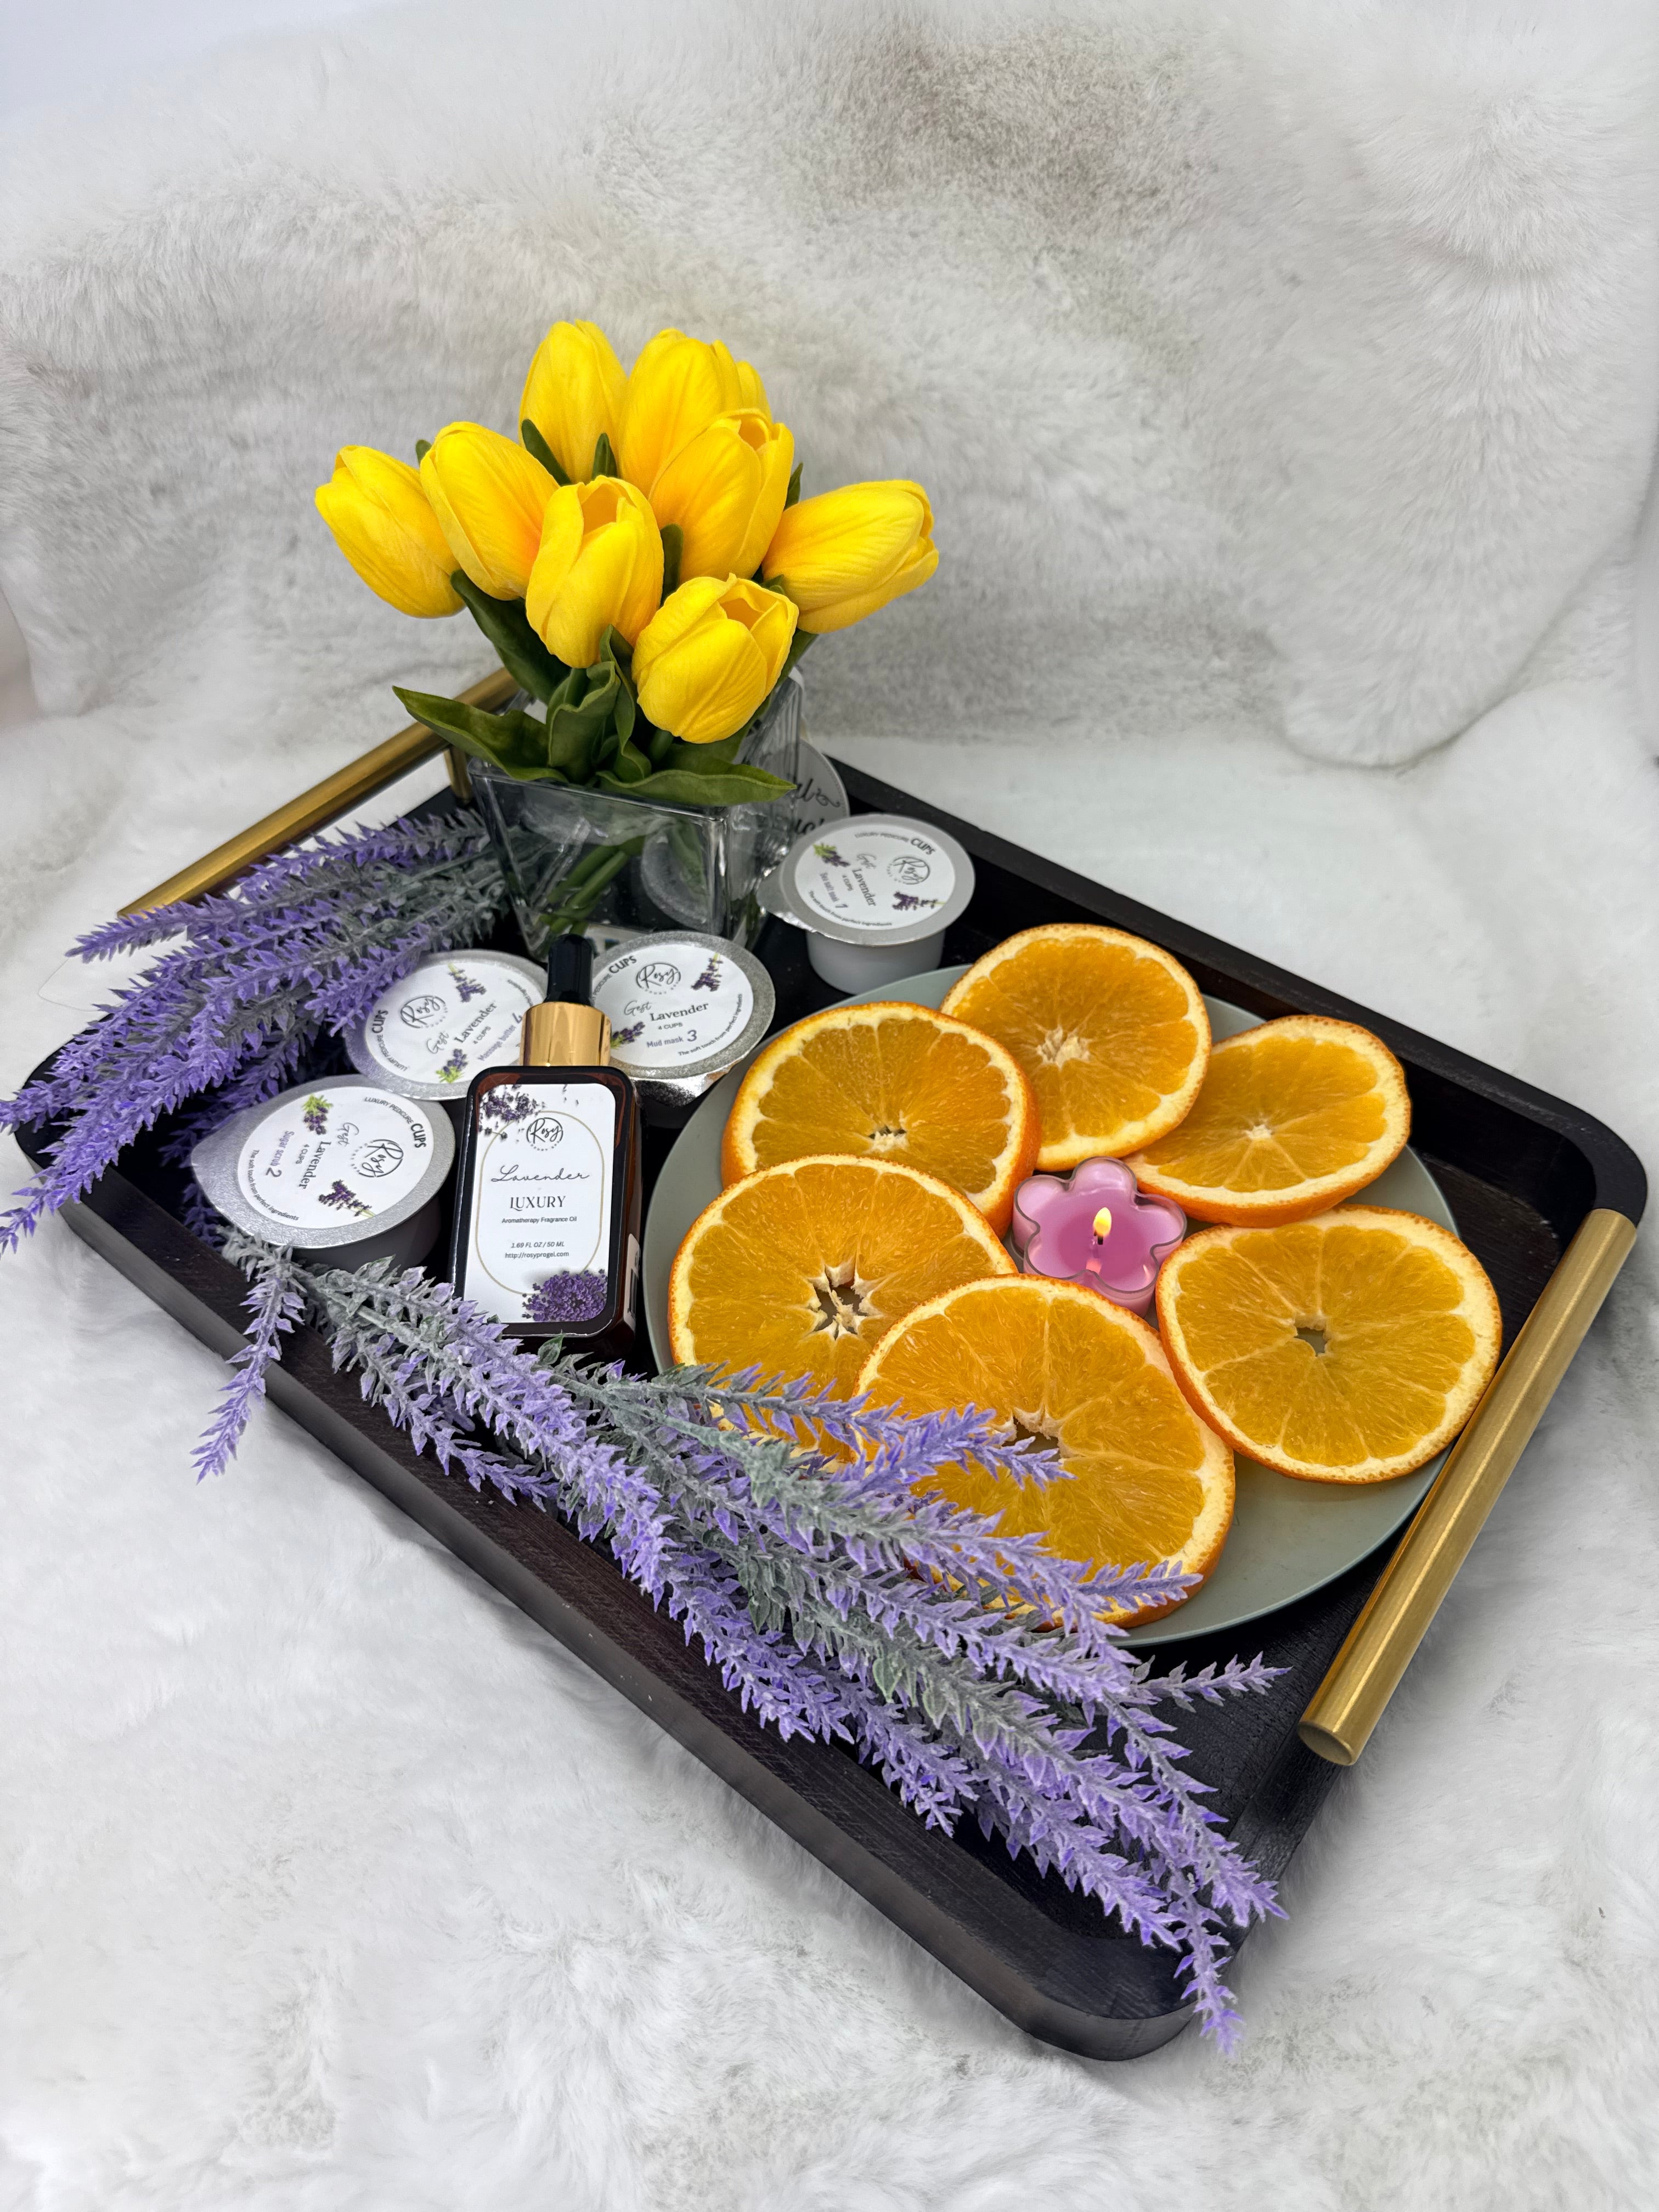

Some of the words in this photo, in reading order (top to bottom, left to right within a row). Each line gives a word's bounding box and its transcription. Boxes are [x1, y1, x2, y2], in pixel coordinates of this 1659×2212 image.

[911, 838, 935, 855] CUPS
[852, 868, 876, 906] Lavender
[593, 973, 613, 996] PEDICURE
[609, 956, 636, 973] CUPS
[639, 965, 678, 989] Rosy
[400, 997, 440, 1025] Rosy
[650, 1003, 709, 1022] Lavender
[372, 1010, 388, 1033] CUPS
[453, 1003, 496, 1043] Lavender
[476, 1025, 491, 1041] CUPS
[664, 1036, 684, 1045] mask
[687, 1030, 697, 1042] 3
[701, 1040, 715, 1049] touch
[715, 1031, 726, 1041] from
[725, 1016, 737, 1033] perfect
[477, 1041, 503, 1061] Massage
[499, 1025, 516, 1041] butter
[387, 1057, 408, 1071] LUXURY
[364, 1097, 391, 1106] LUXURY
[389, 1104, 414, 1124] PEDICURE
[411, 1124, 426, 1148] CUPS
[529, 1118, 562, 1144] Rosy
[279, 1131, 295, 1148] Sugar
[251, 1150, 259, 1158] The
[270, 1149, 284, 1166] scrub
[295, 1149, 308, 1164] CUPS
[362, 1142, 403, 1177] Rosy
[265, 1167, 282, 1177] 2
[299, 1141, 331, 1189] Lavender
[491, 1165, 590, 1182] Lavender
[250, 1183, 258, 1194] from
[255, 1194, 270, 1207] perfect
[510, 1195, 566, 1211] LUXURY
[269, 1206, 299, 1220] ingredients
